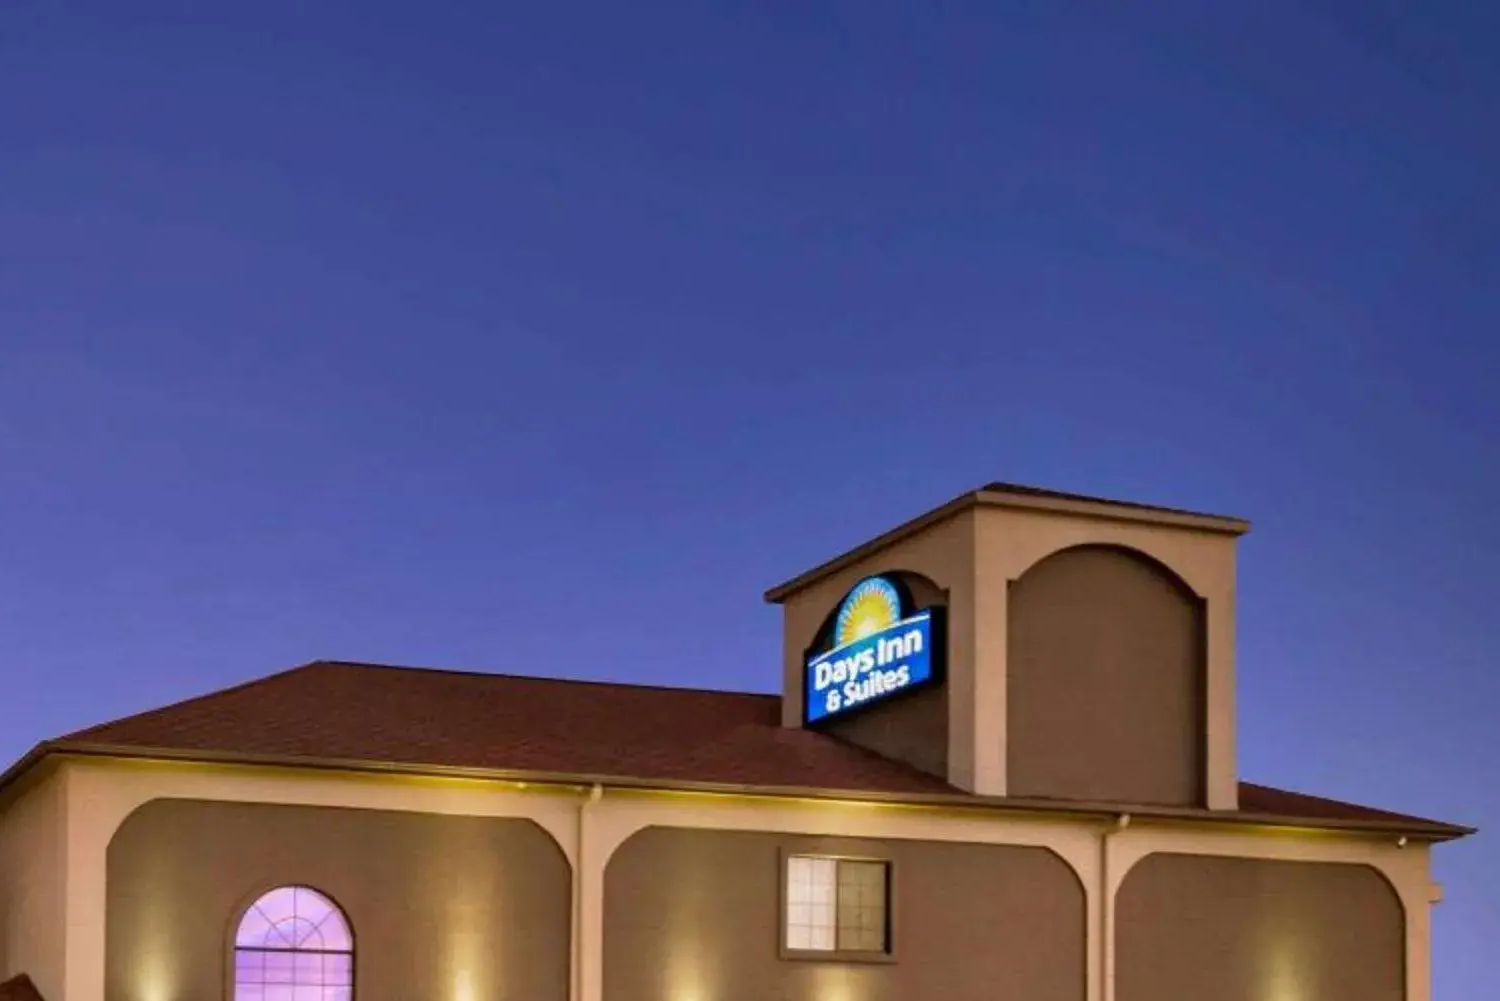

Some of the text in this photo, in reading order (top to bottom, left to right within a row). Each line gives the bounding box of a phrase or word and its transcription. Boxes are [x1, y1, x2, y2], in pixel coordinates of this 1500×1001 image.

[815, 629, 922, 690] Days Inn
[826, 665, 910, 713] & Suites
